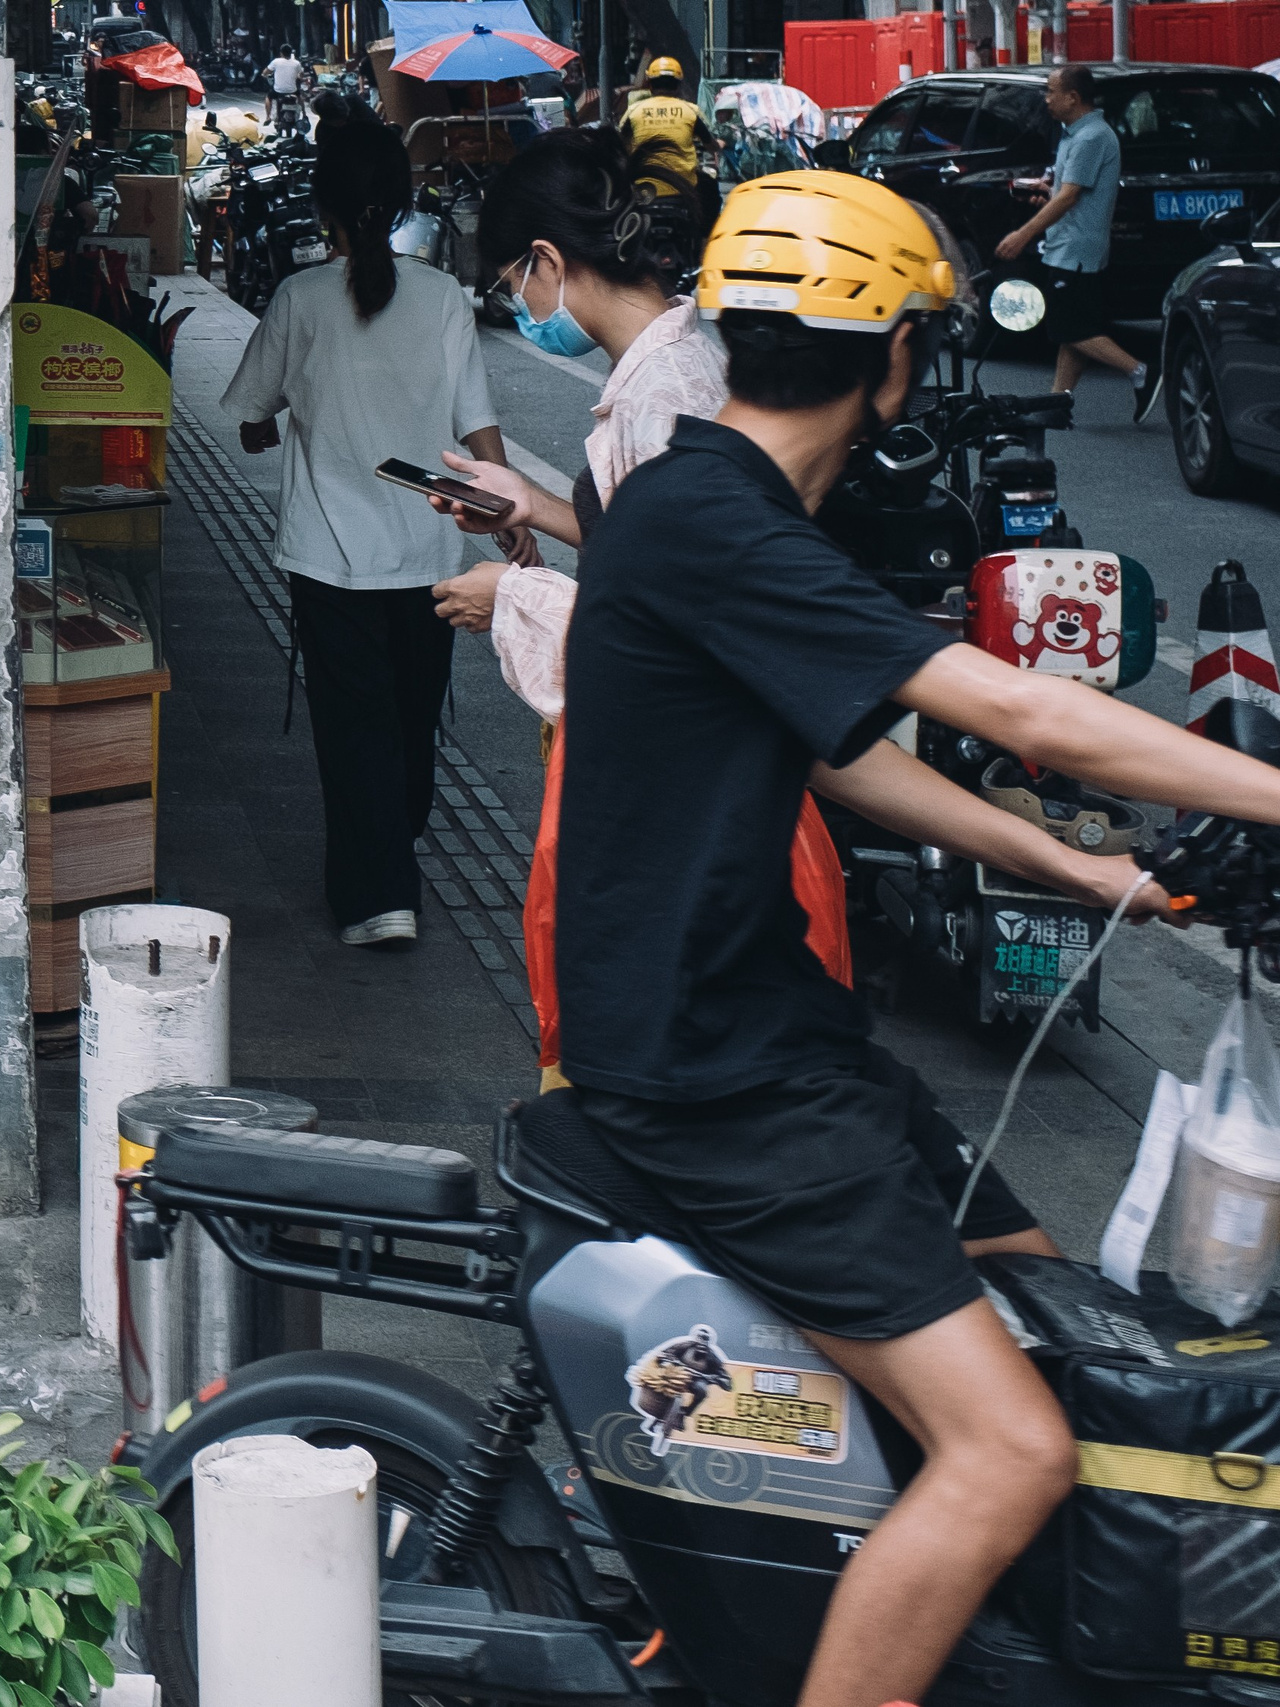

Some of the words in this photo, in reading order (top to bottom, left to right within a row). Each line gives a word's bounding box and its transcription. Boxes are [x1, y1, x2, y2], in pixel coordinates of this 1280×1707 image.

[44, 360, 122, 378] 枸杞槟榔
[1028, 915, 1090, 948] 雅迪
